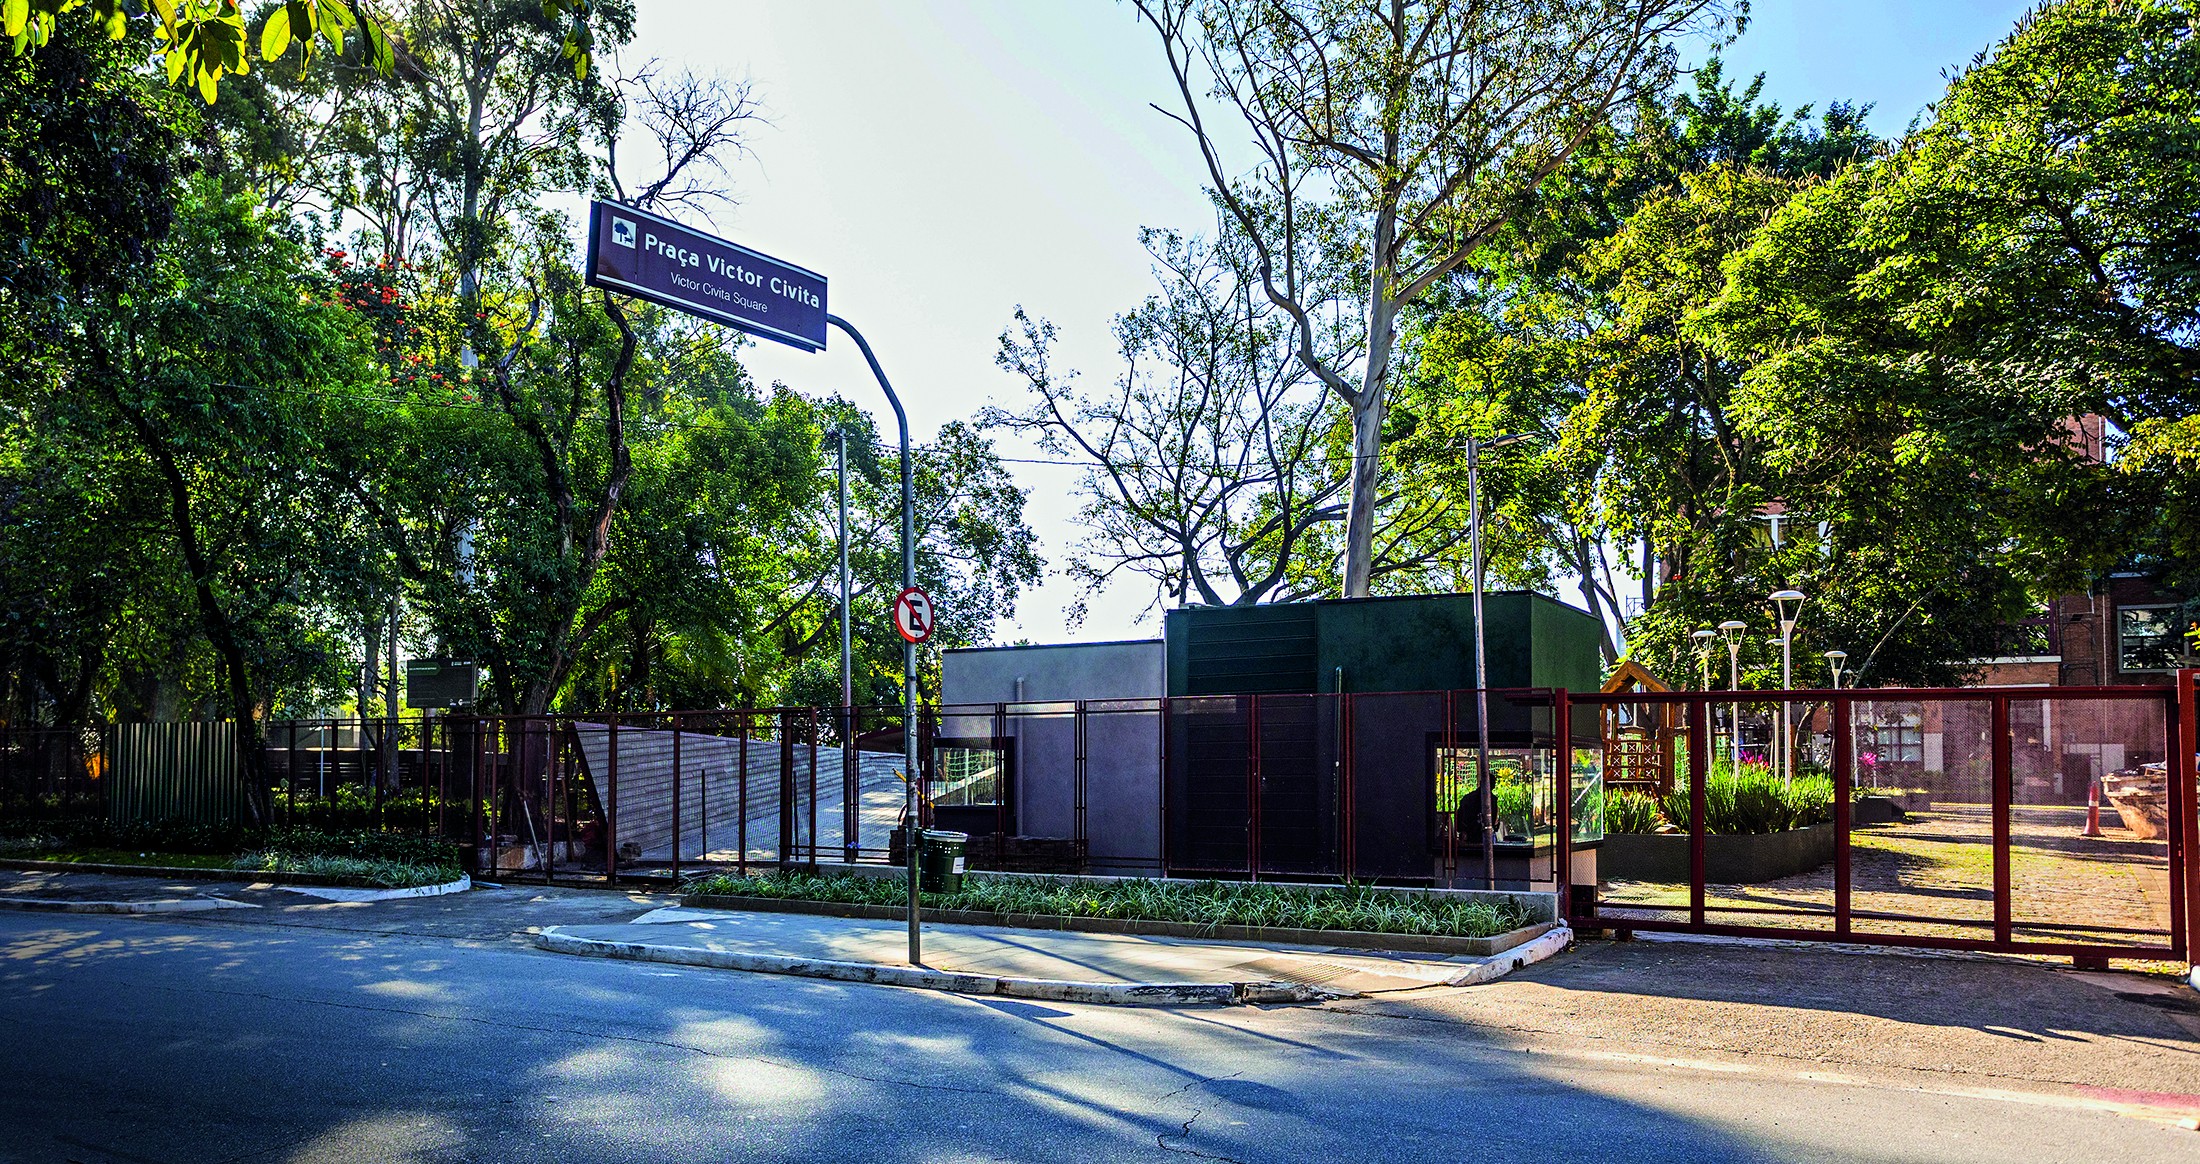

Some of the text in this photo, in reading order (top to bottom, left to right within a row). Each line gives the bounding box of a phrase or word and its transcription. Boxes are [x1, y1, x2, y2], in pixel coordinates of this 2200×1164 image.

[644, 233, 820, 309] Praça Victor Civita
[670, 271, 768, 313] Victor Civita Square
[909, 600, 923, 631] E
